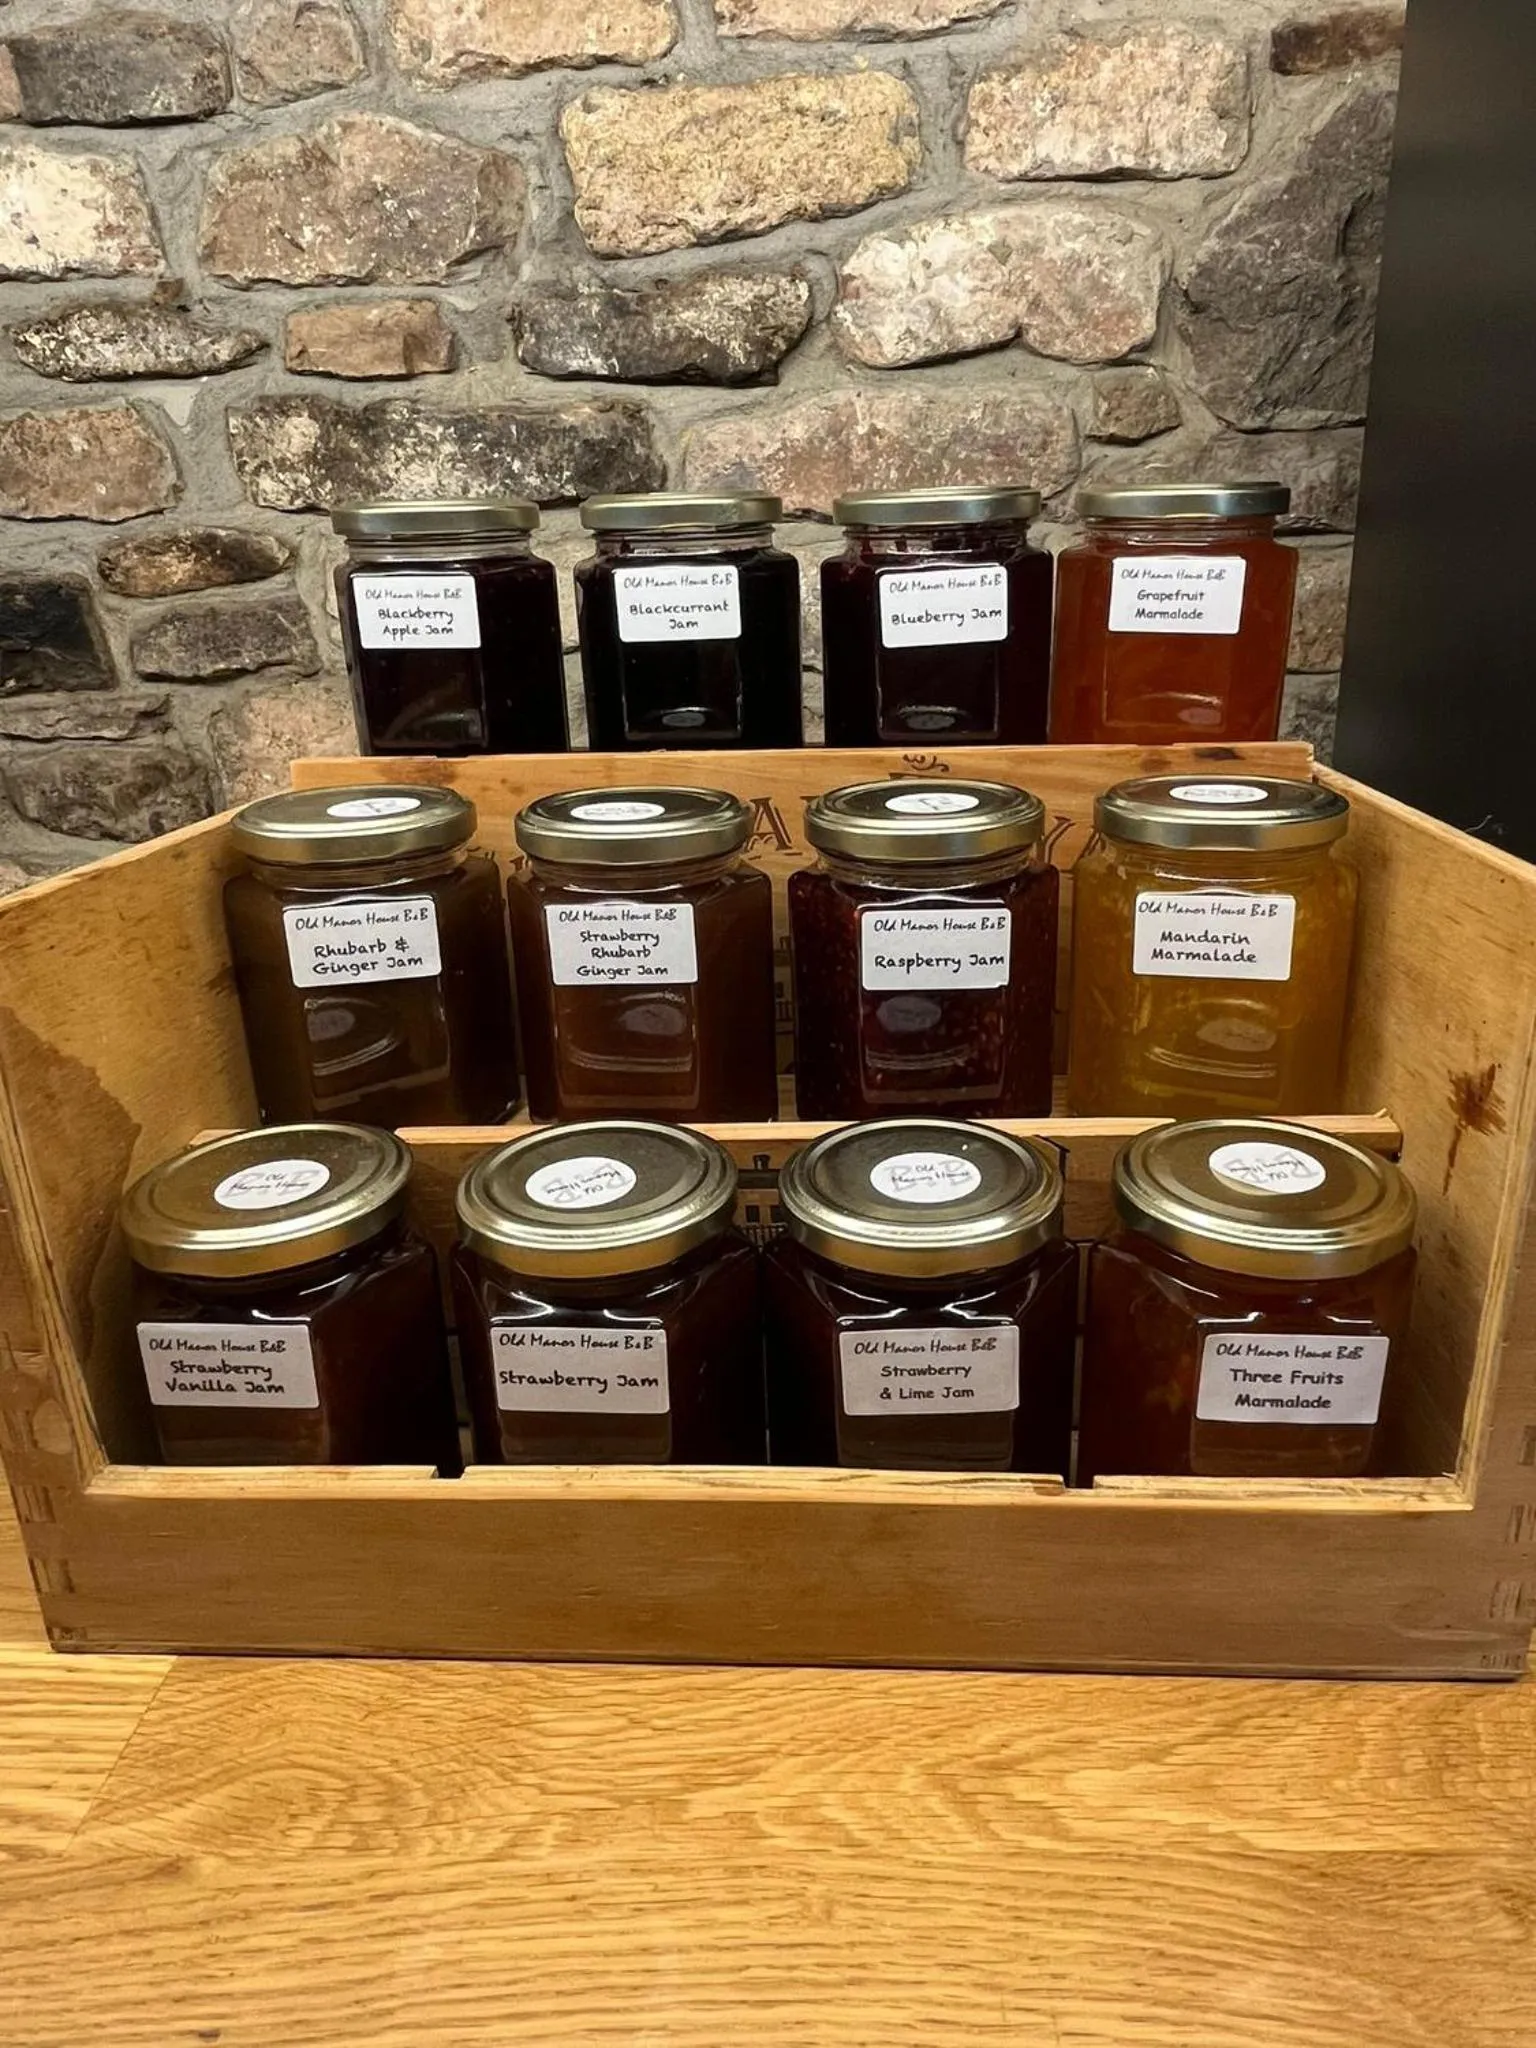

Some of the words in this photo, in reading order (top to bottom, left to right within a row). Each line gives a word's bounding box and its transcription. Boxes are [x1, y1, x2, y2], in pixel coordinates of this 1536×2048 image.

[1121, 569, 1139, 579] Old
[1142, 569, 1173, 579] Manor
[1176, 568, 1203, 579] House
[624, 577, 642, 588] Old
[645, 577, 677, 587] Manor
[681, 576, 708, 586] House
[889, 582, 908, 593] Old
[911, 580, 944, 591] Manor
[948, 578, 976, 589] House
[365, 589, 382, 599] Old
[384, 589, 413, 599] Manor
[416, 590, 440, 599] House
[1137, 589, 1204, 602] Grapefruit
[629, 600, 729, 615] Blackcurrant
[1135, 608, 1204, 619] Marmalade
[378, 607, 453, 624] Blackberry
[891, 609, 965, 627] Blueberry
[971, 608, 1002, 619] Jam
[669, 619, 698, 629] Jam
[383, 625, 420, 641] Apple
[425, 625, 453, 635] Jam
[1138, 901, 1163, 913] Old
[1166, 902, 1206, 915] Manor
[1211, 902, 1246, 915] House
[295, 916, 319, 930] Old
[322, 915, 362, 928] Manor
[366, 912, 400, 925] House
[559, 910, 580, 922] Old
[582, 912, 618, 921] Manor
[621, 910, 651, 921] House
[874, 919, 896, 932] Old
[900, 919, 938, 930] Manor
[943, 918, 977, 931] House
[579, 928, 660, 947] Strawberry
[1160, 929, 1251, 945] Mandarin
[314, 938, 386, 958] Rhubarb
[395, 936, 409, 953] &
[591, 945, 651, 958] Rhubarb
[1151, 948, 1257, 963] Marmalade
[312, 960, 378, 976] Ginger
[387, 956, 423, 968] Jam
[874, 953, 961, 975] Raspberry
[969, 954, 1004, 966] Jam
[576, 965, 631, 979] Ginger
[637, 965, 668, 975] Jam
[149, 1339, 173, 1350] Old
[176, 1339, 217, 1351] Manor
[221, 1339, 255, 1352] House
[500, 1333, 526, 1346] Old
[530, 1334, 575, 1347] Manor
[580, 1334, 619, 1349] House
[854, 1342, 878, 1354] Old
[884, 1341, 925, 1354] Manor
[930, 1339, 966, 1353] House
[1216, 1343, 1243, 1356] Old
[1246, 1344, 1289, 1357] Manor
[1294, 1346, 1332, 1360] House
[170, 1359, 272, 1381] Strawberry
[880, 1364, 972, 1378] Strawberry
[1229, 1368, 1282, 1383] Three
[1290, 1370, 1344, 1385] Fruits
[165, 1378, 237, 1392] Vanilla
[244, 1381, 285, 1393] Jam
[499, 1370, 608, 1393] Strawberry
[616, 1375, 659, 1387] Jam
[879, 1387, 892, 1400] &
[899, 1388, 935, 1399] Lime
[941, 1387, 974, 1398] Jam
[1235, 1394, 1331, 1409] Marmalade
